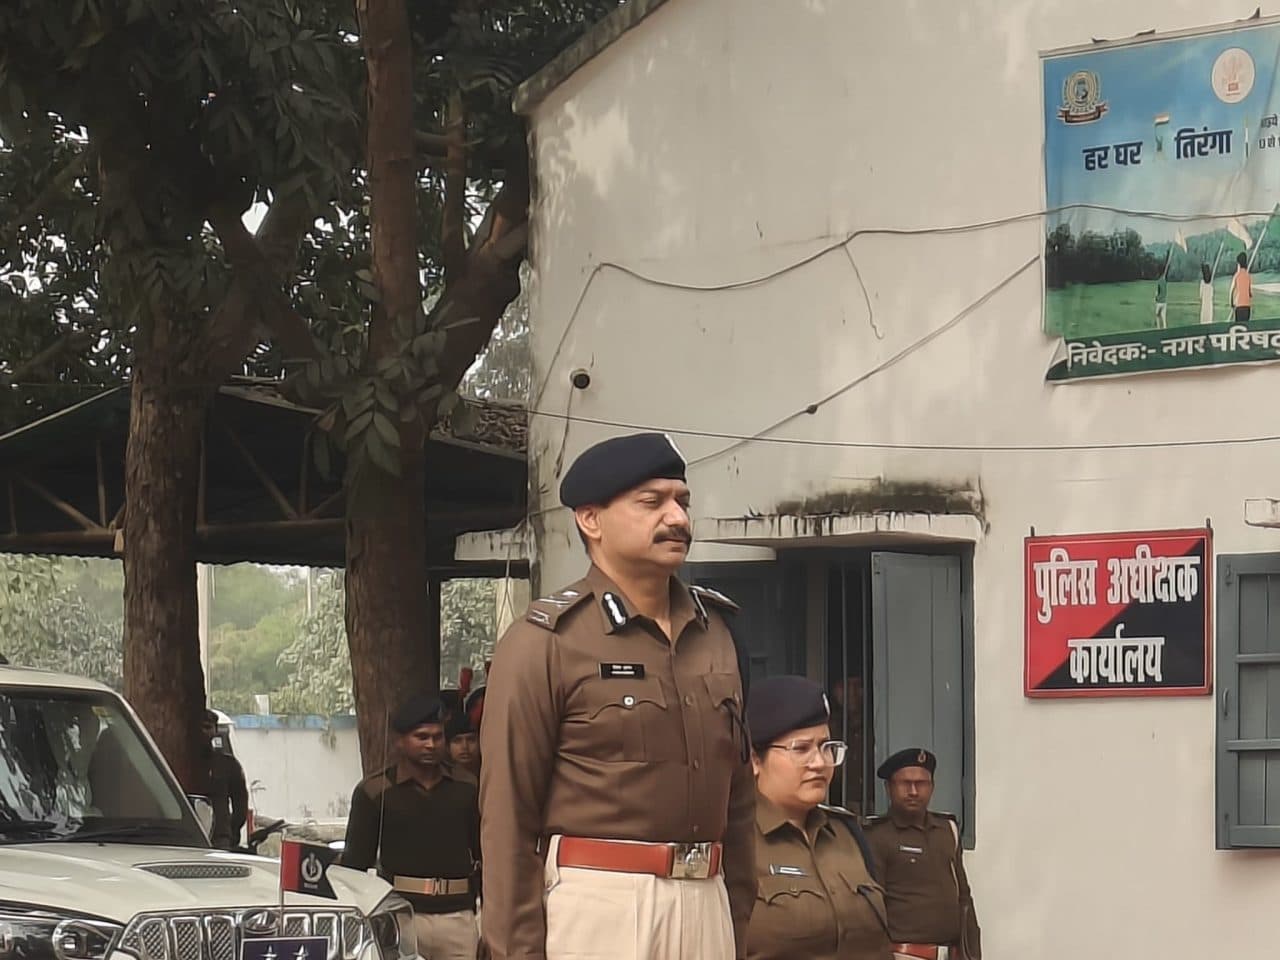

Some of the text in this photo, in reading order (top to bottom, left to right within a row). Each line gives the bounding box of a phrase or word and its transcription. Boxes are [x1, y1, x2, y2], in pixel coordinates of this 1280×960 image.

[1082, 126, 1233, 171] हर घर तिरंगा
[1161, 333, 1207, 358] नगर
[1033, 544, 1201, 624] पुलिस अधीक्षक
[1067, 623, 1165, 684] कार्यालय
